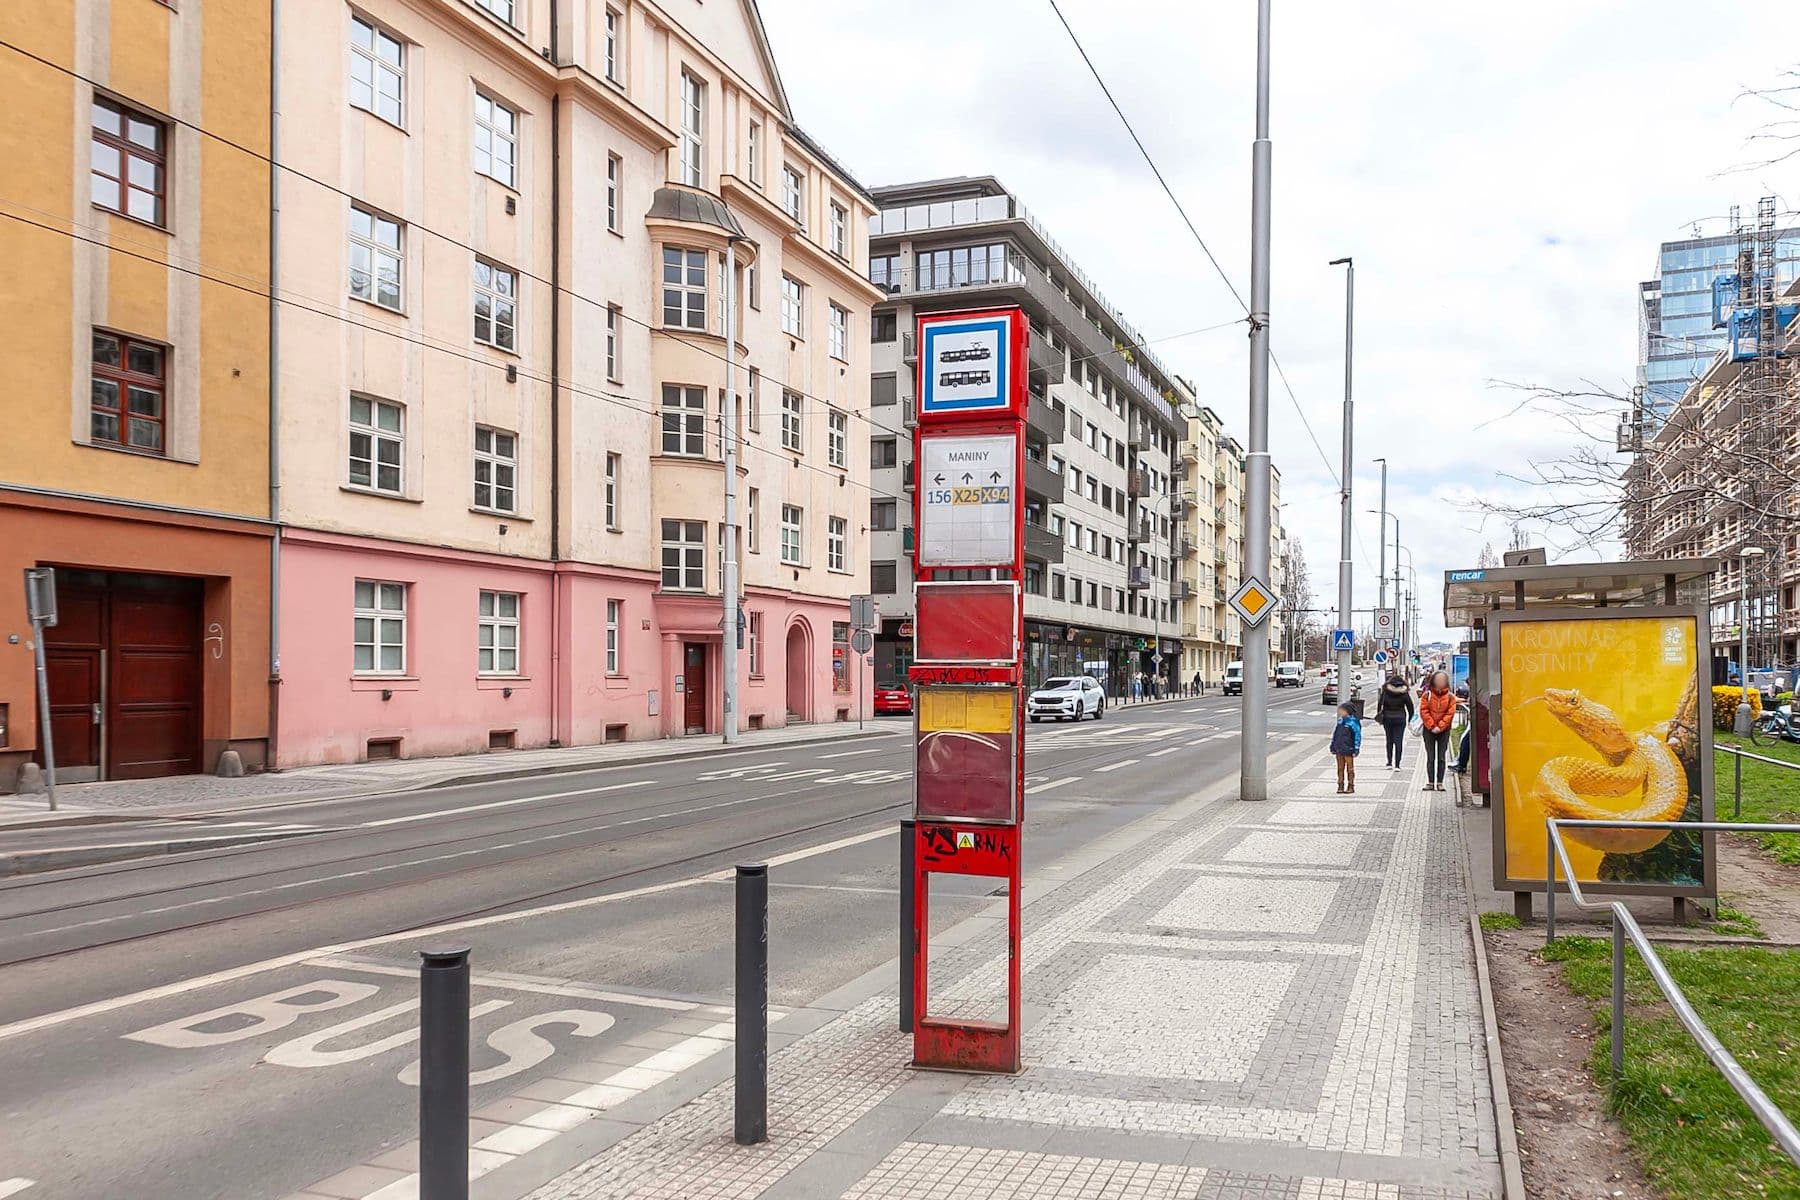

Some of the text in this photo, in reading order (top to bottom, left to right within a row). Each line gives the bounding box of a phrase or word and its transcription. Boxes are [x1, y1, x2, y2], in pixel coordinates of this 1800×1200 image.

[948, 451, 990, 462] MANINY
[928, 487, 1009, 504] 156 X25 X94
[1451, 571, 1483, 580] rencar
[120, 979, 616, 1086] BUS
